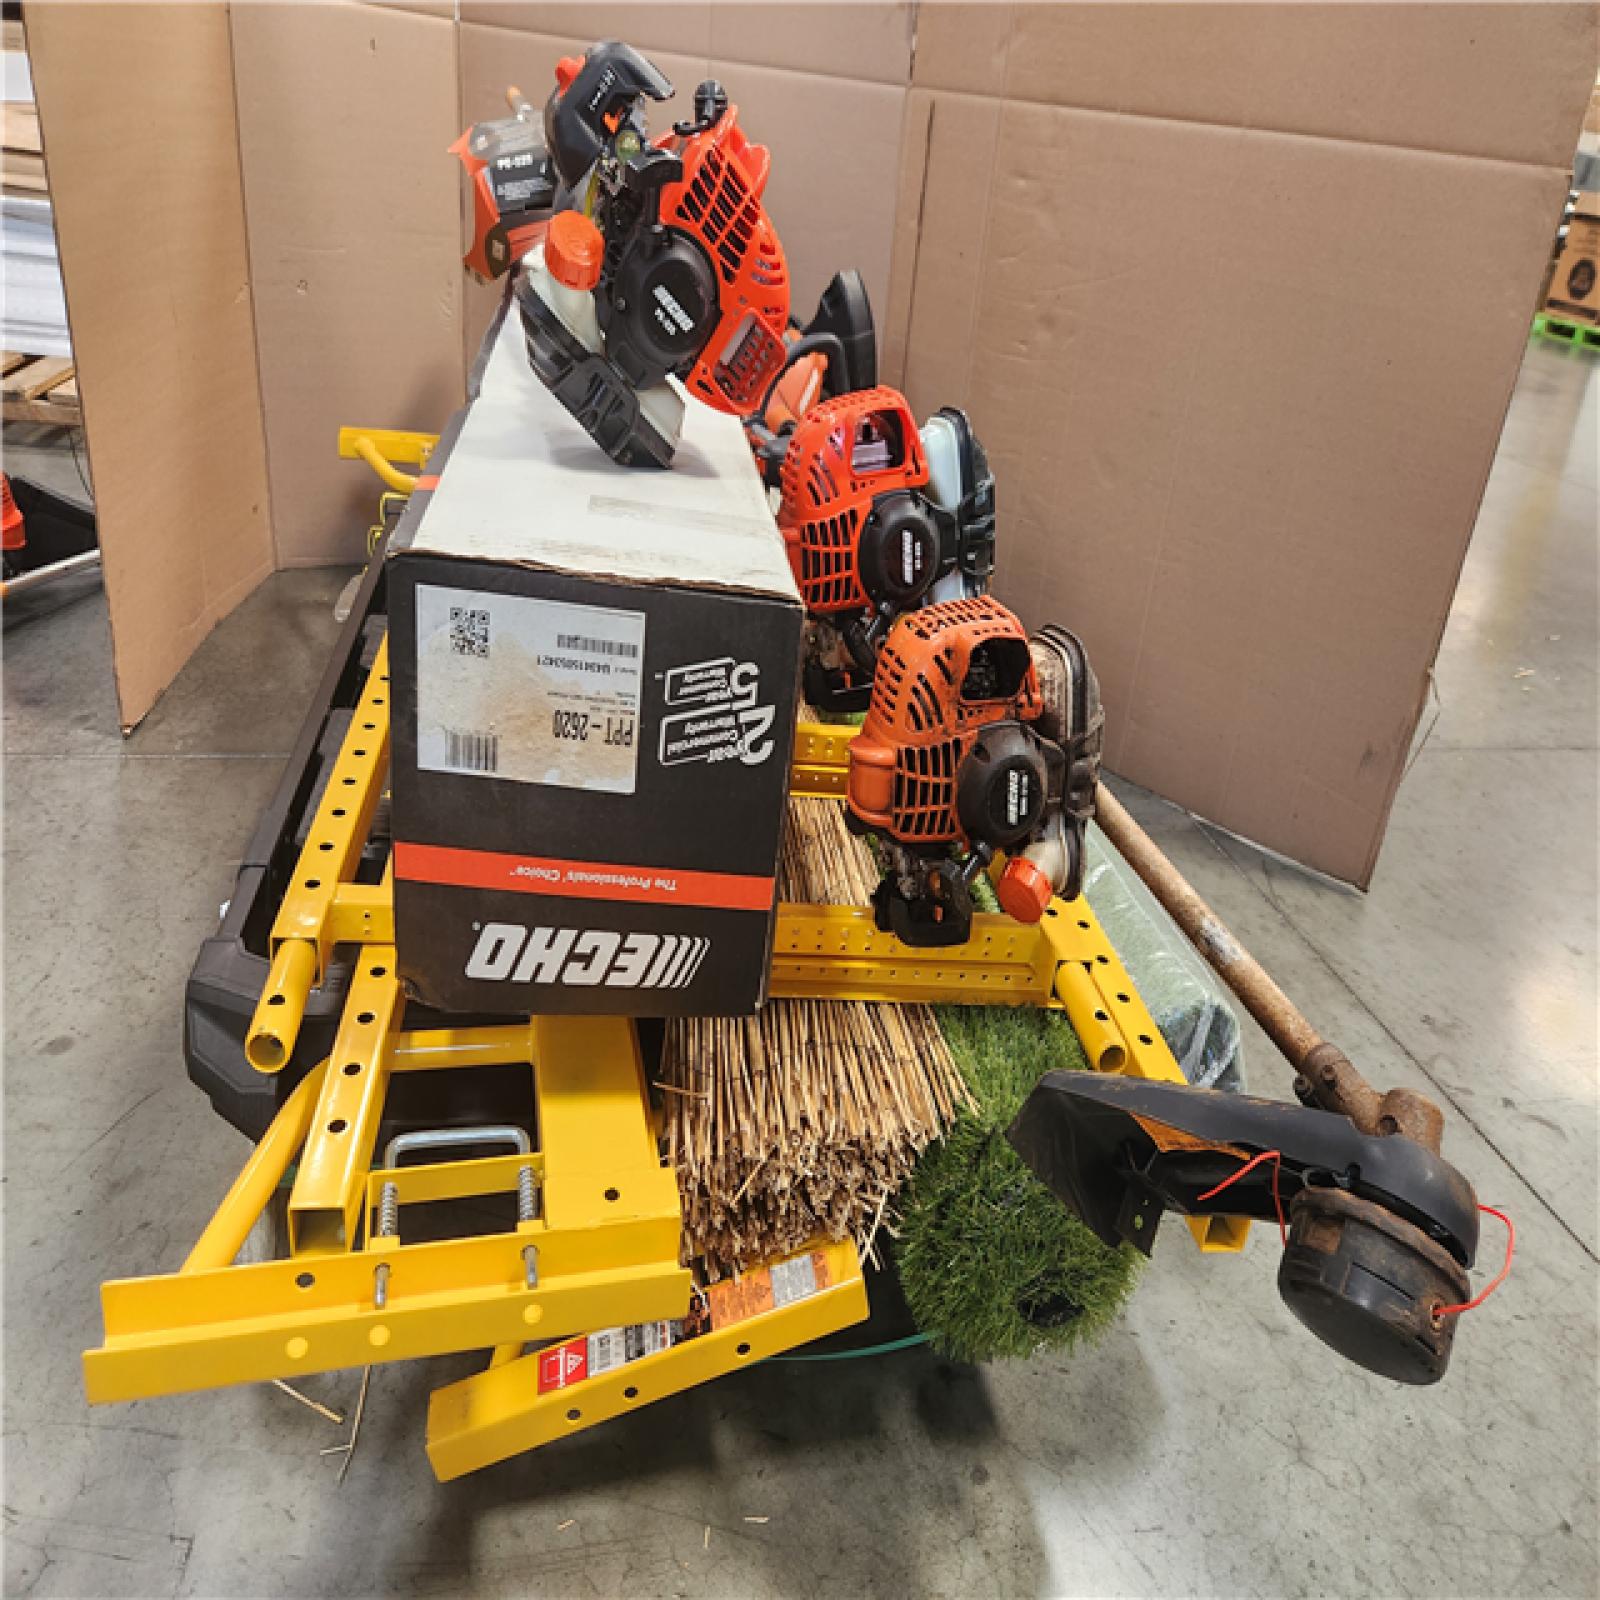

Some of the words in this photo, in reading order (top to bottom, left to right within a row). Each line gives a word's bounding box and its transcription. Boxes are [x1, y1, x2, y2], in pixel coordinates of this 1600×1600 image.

[730, 662, 760, 710] 5
[554, 709, 634, 747] PPT-2620
[739, 705, 776, 765] 2
[654, 877, 677, 892] The
[464, 921, 712, 989] ECHO
